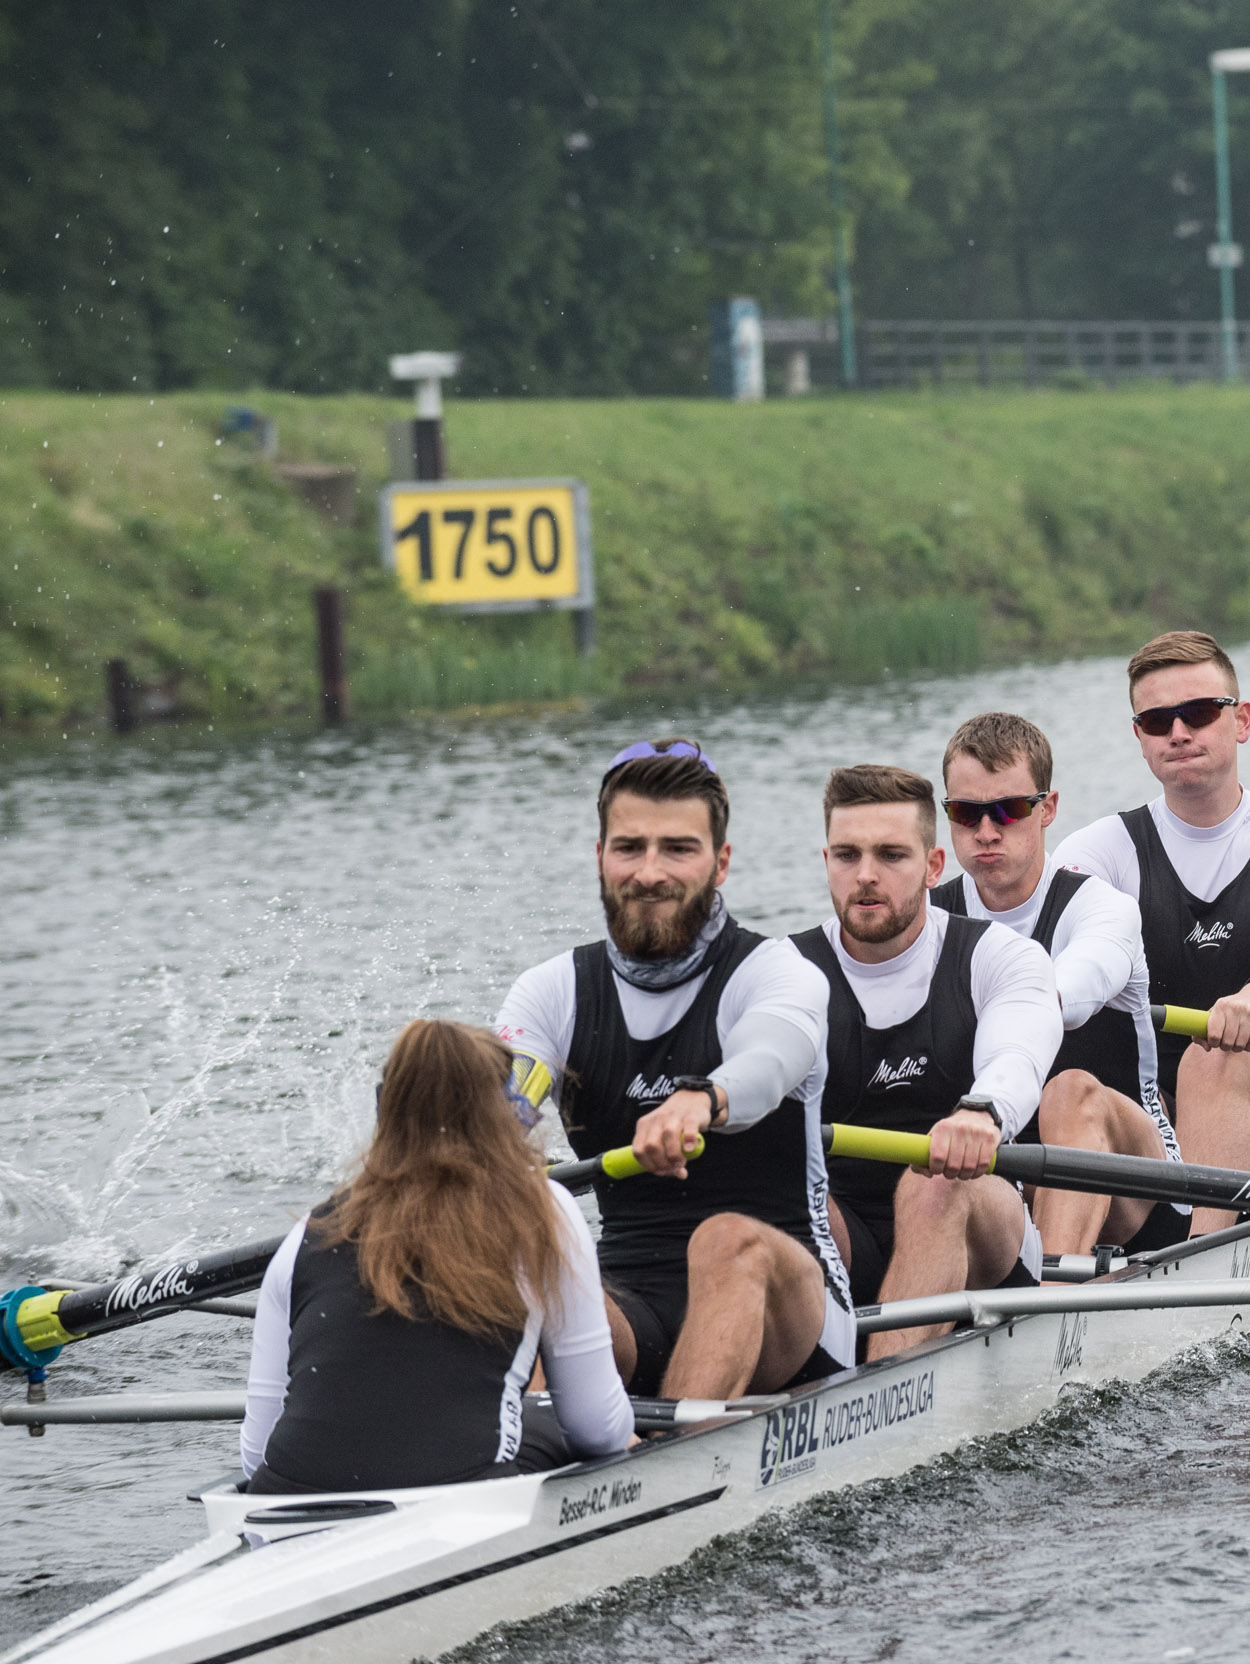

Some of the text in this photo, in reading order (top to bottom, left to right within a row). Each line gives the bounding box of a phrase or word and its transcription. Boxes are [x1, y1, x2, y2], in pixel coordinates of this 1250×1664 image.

[394, 507, 560, 580] 1750
[780, 1398, 819, 1463] RBL
[822, 1370, 935, 1450] RUDER-BUNDESLIGA
[608, 1476, 643, 1510] Minden
